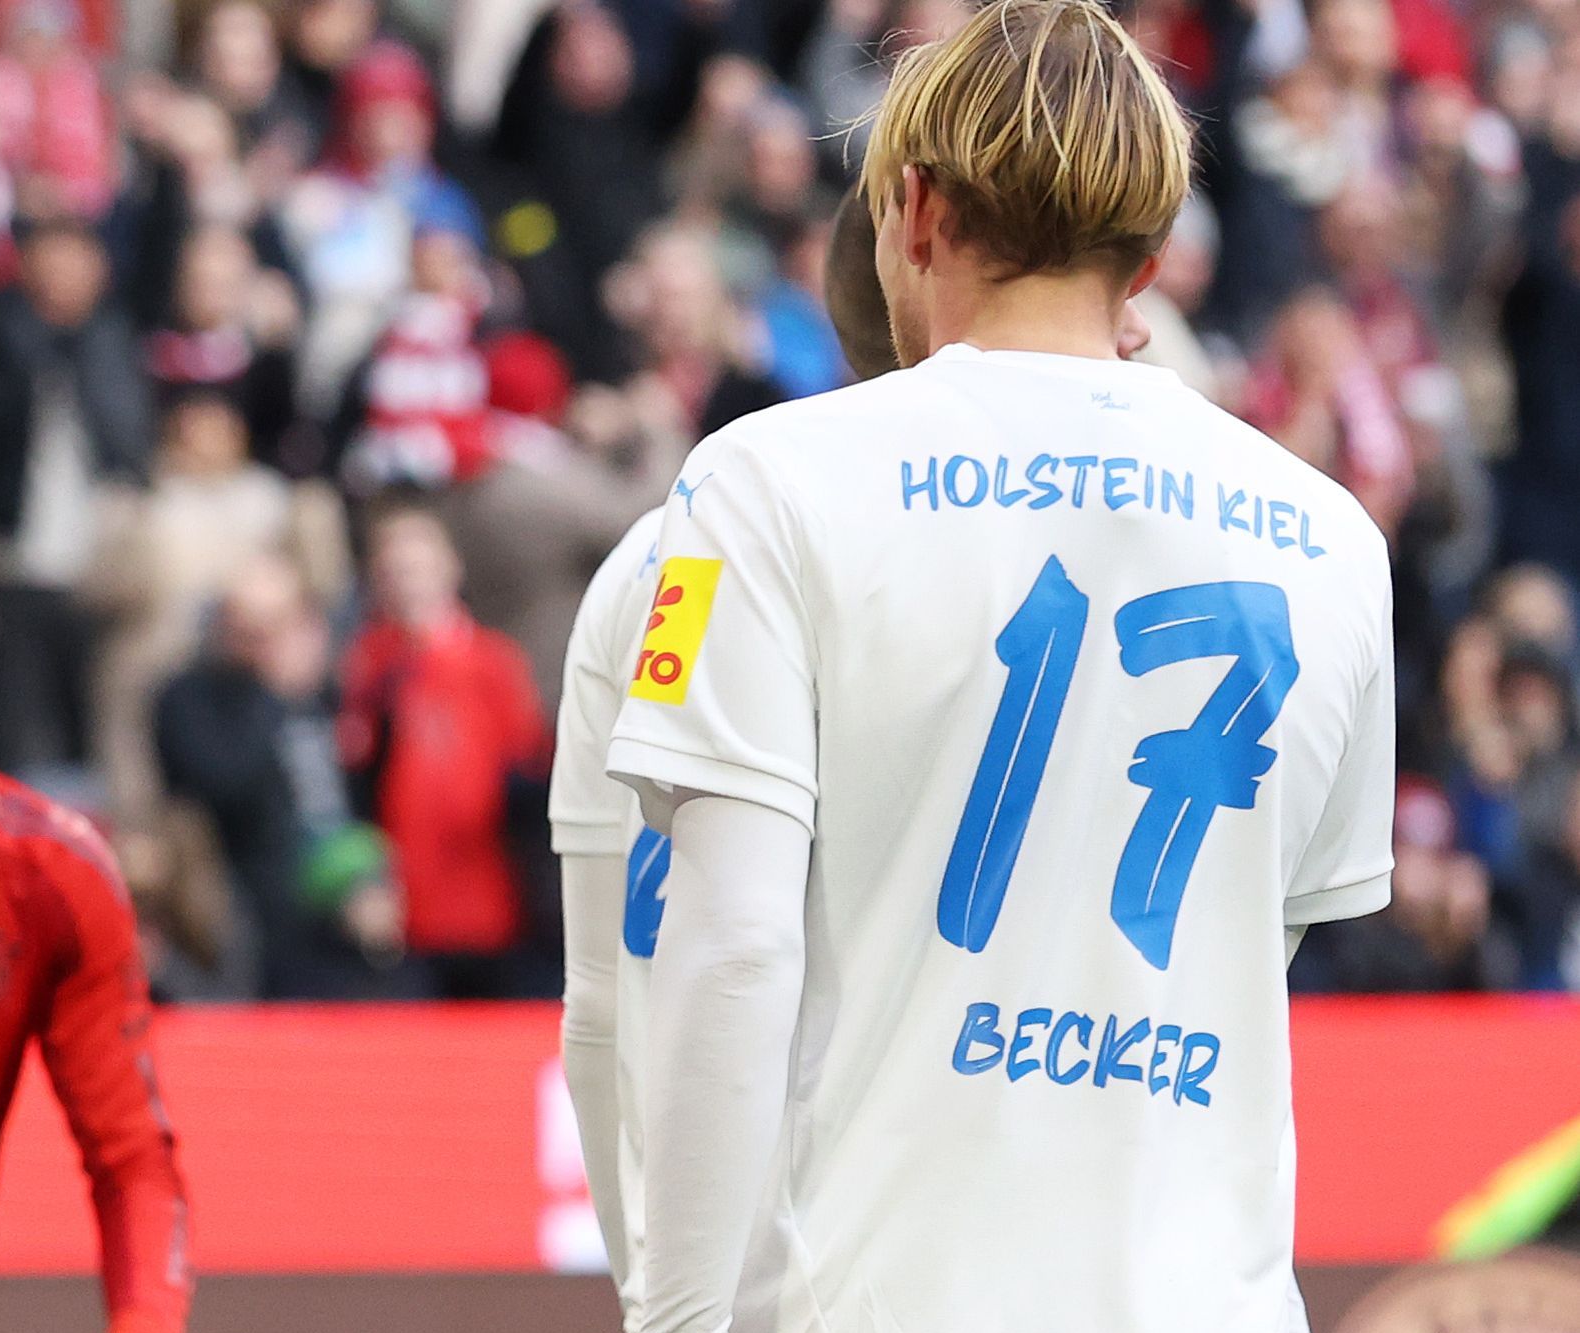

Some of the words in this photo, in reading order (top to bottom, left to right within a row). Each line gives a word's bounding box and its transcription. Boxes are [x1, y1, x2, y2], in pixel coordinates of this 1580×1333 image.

[900, 452, 1194, 520] HOLSTEIN
[1216, 482, 1328, 560] KIEL
[936, 553, 1300, 971] 17
[952, 1002, 1220, 1108] BECKER
